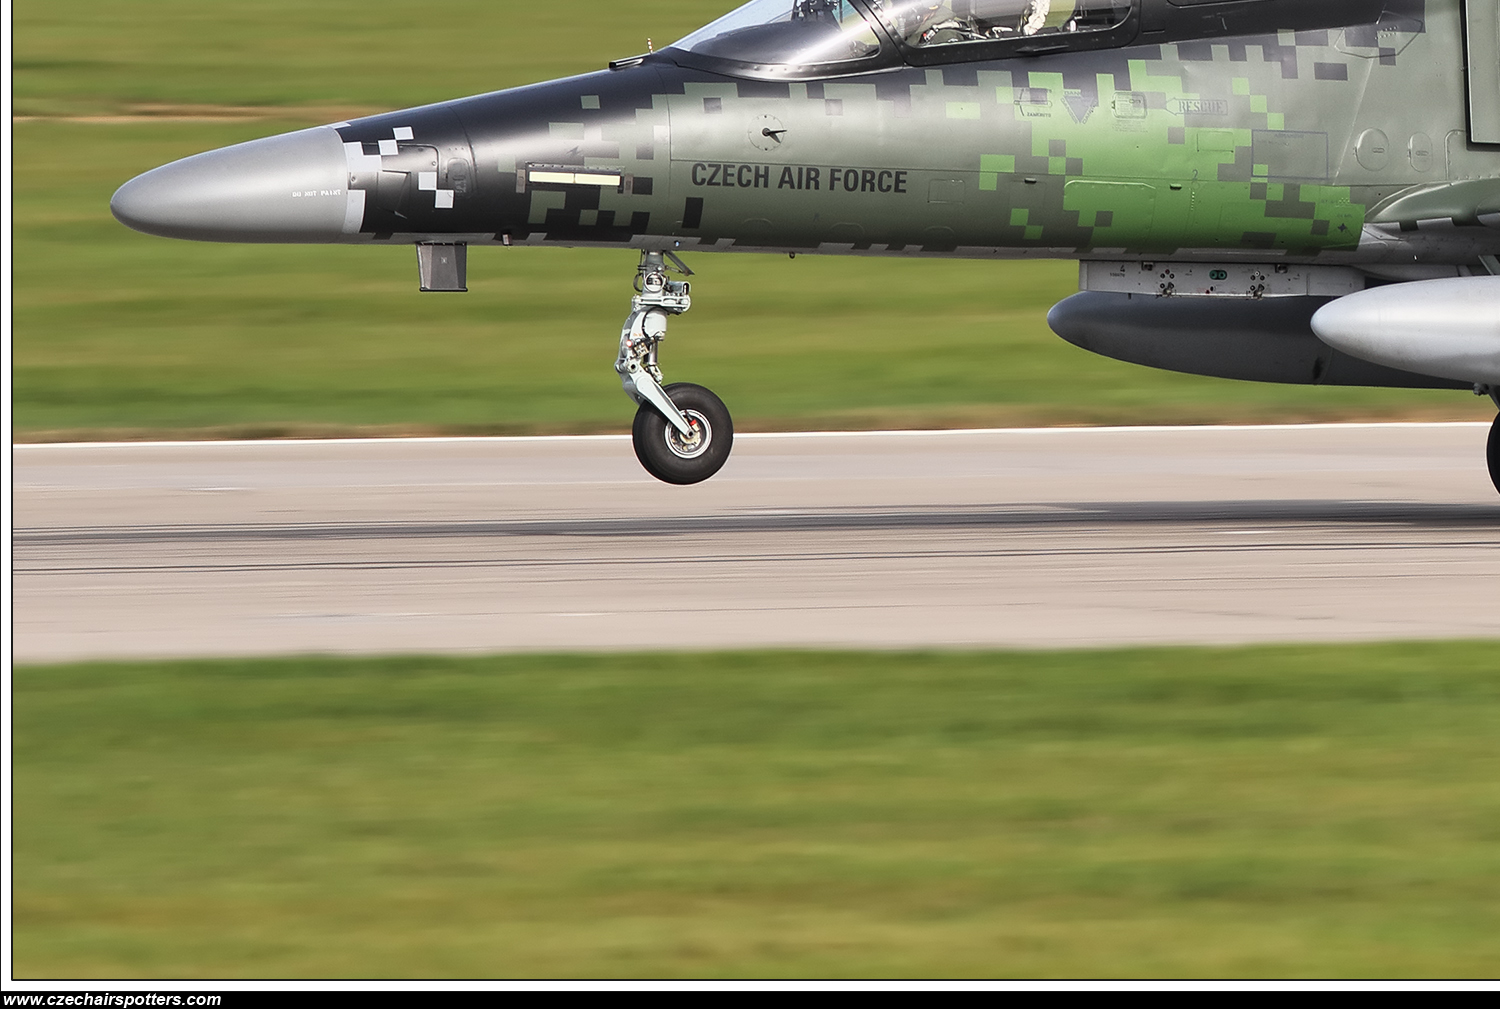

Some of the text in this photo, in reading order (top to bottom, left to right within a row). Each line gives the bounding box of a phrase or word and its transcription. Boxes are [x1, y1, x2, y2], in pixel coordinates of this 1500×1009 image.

[1179, 100, 1224, 114] RESCUE
[691, 163, 908, 193] CZECH AIR FORCE
